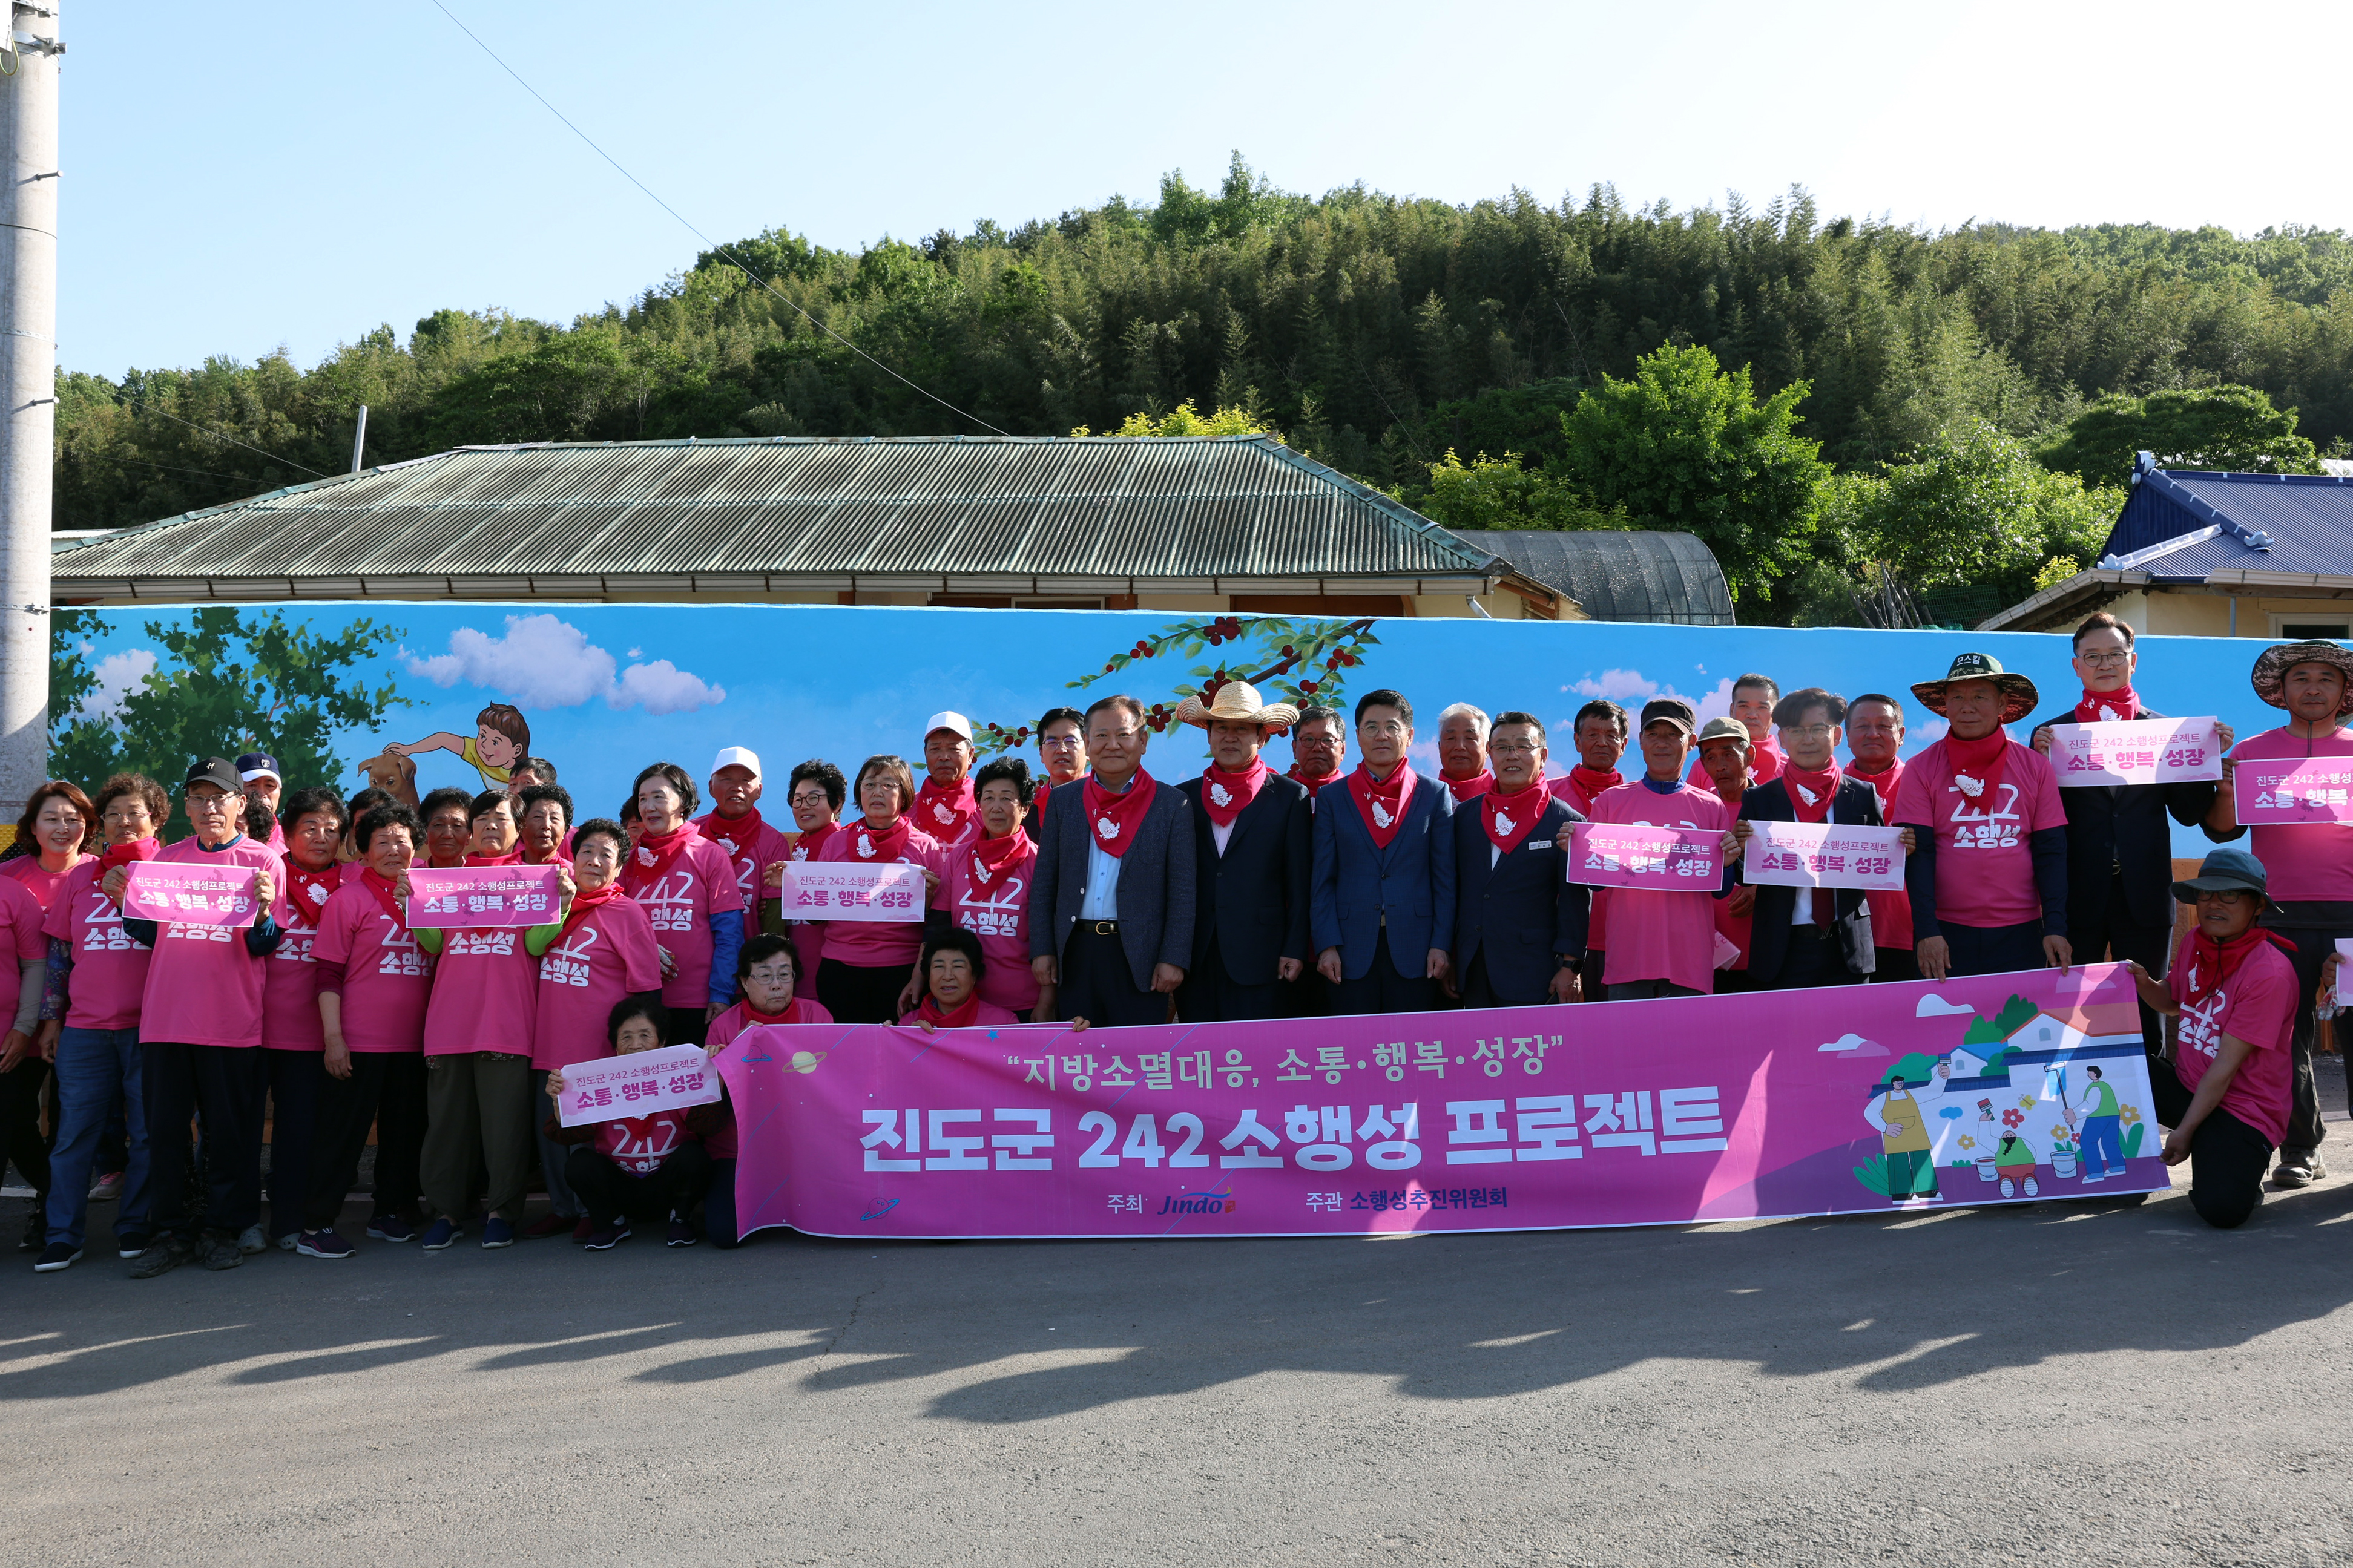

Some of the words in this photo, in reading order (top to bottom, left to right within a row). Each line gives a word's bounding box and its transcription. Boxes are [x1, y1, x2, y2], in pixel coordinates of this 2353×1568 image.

[1956, 655, 1980, 666] 모스킬
[2068, 738, 2099, 750] 진도군
[2103, 738, 2122, 747] 242
[2126, 733, 2201, 745] 소행성프로젝트
[2256, 775, 2289, 786] 진도군
[2293, 775, 2314, 784] 242
[2317, 772, 2353, 784] 소행성
[1766, 838, 1795, 848] 진도군
[1799, 839, 1817, 848] 242
[1820, 841, 1889, 853] 소행성프로젝트
[1953, 824, 2021, 848] 소행성
[1588, 838, 1617, 850] 진도군
[1621, 841, 1639, 850] 242
[1642, 842, 1710, 855] 소행성프로젝트
[136, 877, 162, 888] 진도군
[164, 879, 180, 888] 242
[183, 879, 245, 891] 소행성프로젝트
[426, 882, 454, 892] 진도군
[457, 882, 475, 891] 242
[478, 880, 544, 891] 소행성프로젝트
[800, 876, 826, 886] 진도군
[848, 877, 910, 887] 소행성프로젝트
[651, 908, 692, 931] 행성
[960, 911, 1019, 936] 소행성
[449, 931, 516, 956] 소행성
[540, 957, 590, 987] 소행성
[576, 1074, 607, 1087] 진도군
[609, 1071, 628, 1081] 242
[631, 1058, 700, 1078] 소행성프로젝트
[859, 1108, 1055, 1172] 진도군
[1446, 1086, 1728, 1165] 프로젝트
[1107, 1193, 1143, 1214] 주최
[1157, 1196, 1222, 1215] Jindo
[1306, 1192, 1343, 1212] 주관
[1349, 1187, 1507, 1210] 소행성추진위원회
